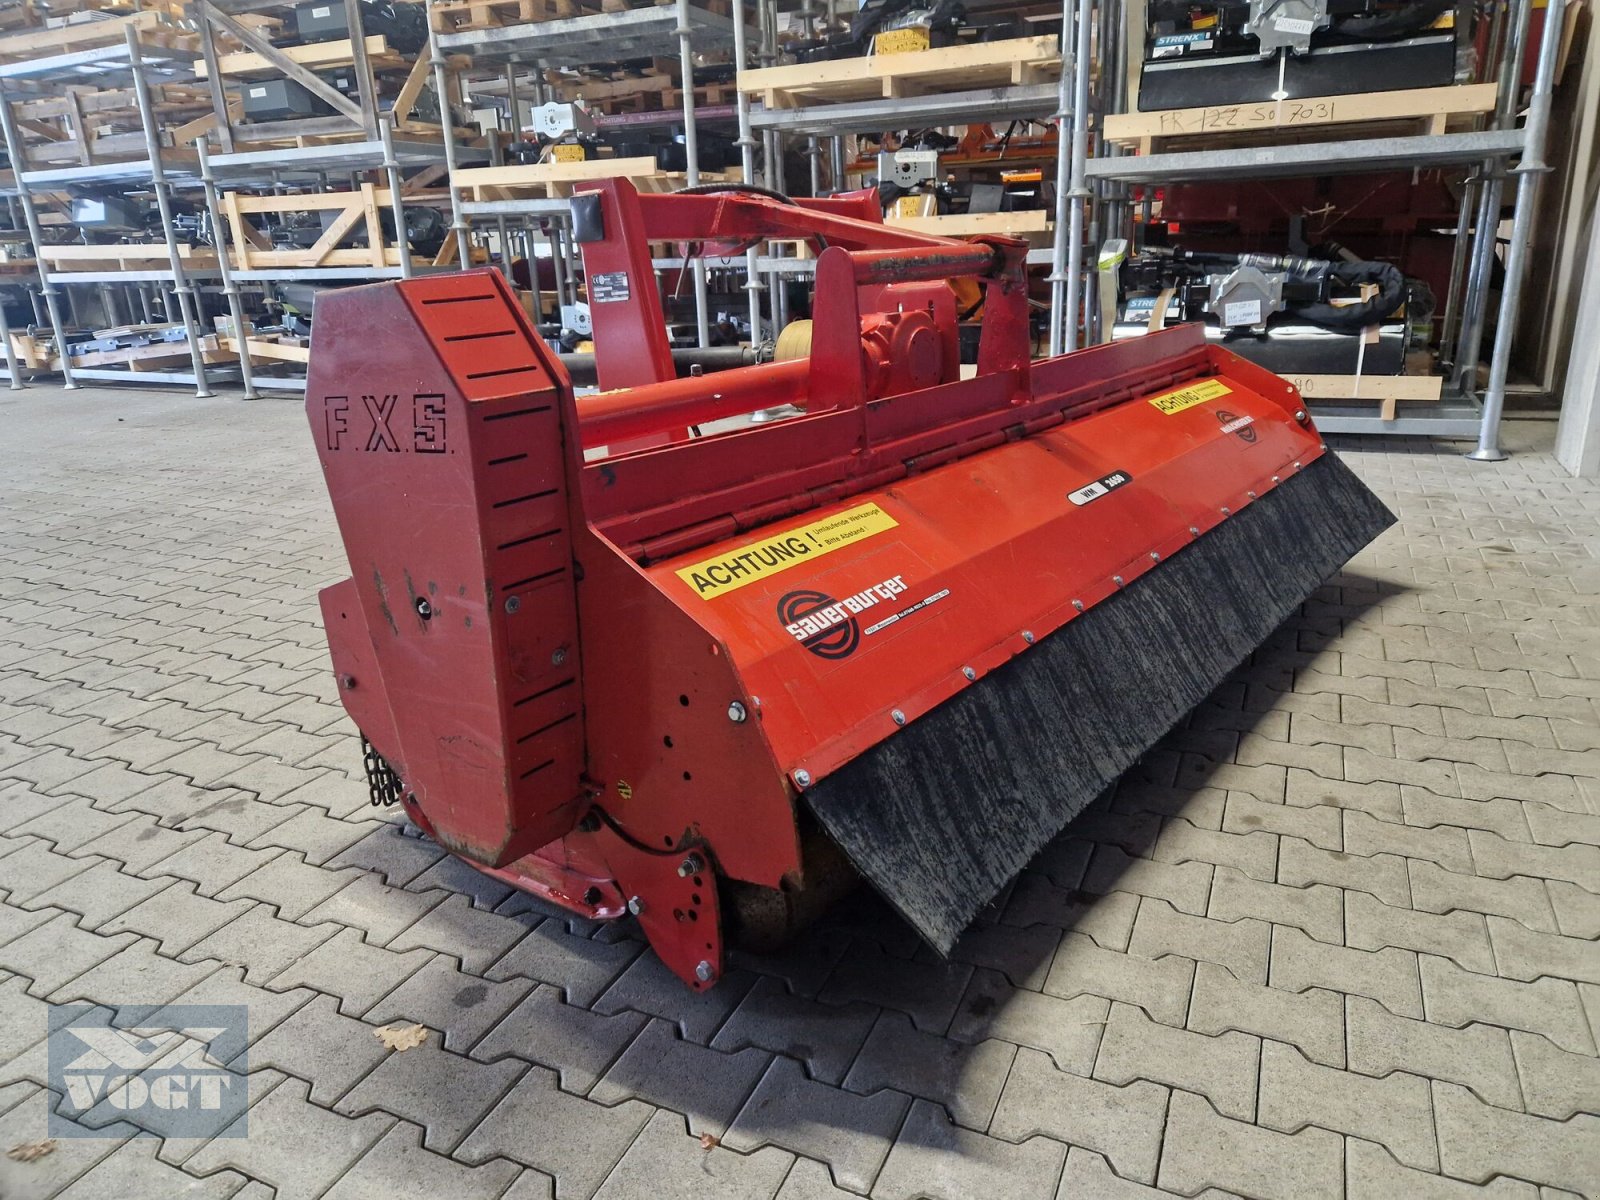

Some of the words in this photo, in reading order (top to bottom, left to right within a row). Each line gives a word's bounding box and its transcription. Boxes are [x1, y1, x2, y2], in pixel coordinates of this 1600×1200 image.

[1157, 33, 1201, 46] STRENX
[1130, 298, 1155, 307] STRE
[1155, 391, 1199, 411] ACHTUNG
[1080, 488, 1097, 498] WM
[812, 519, 849, 536] Umlaufende
[848, 507, 880, 524] Werkzeuge
[824, 535, 840, 546] Bitte
[840, 528, 864, 541] Abstand
[690, 537, 810, 593] ACHTUNG
